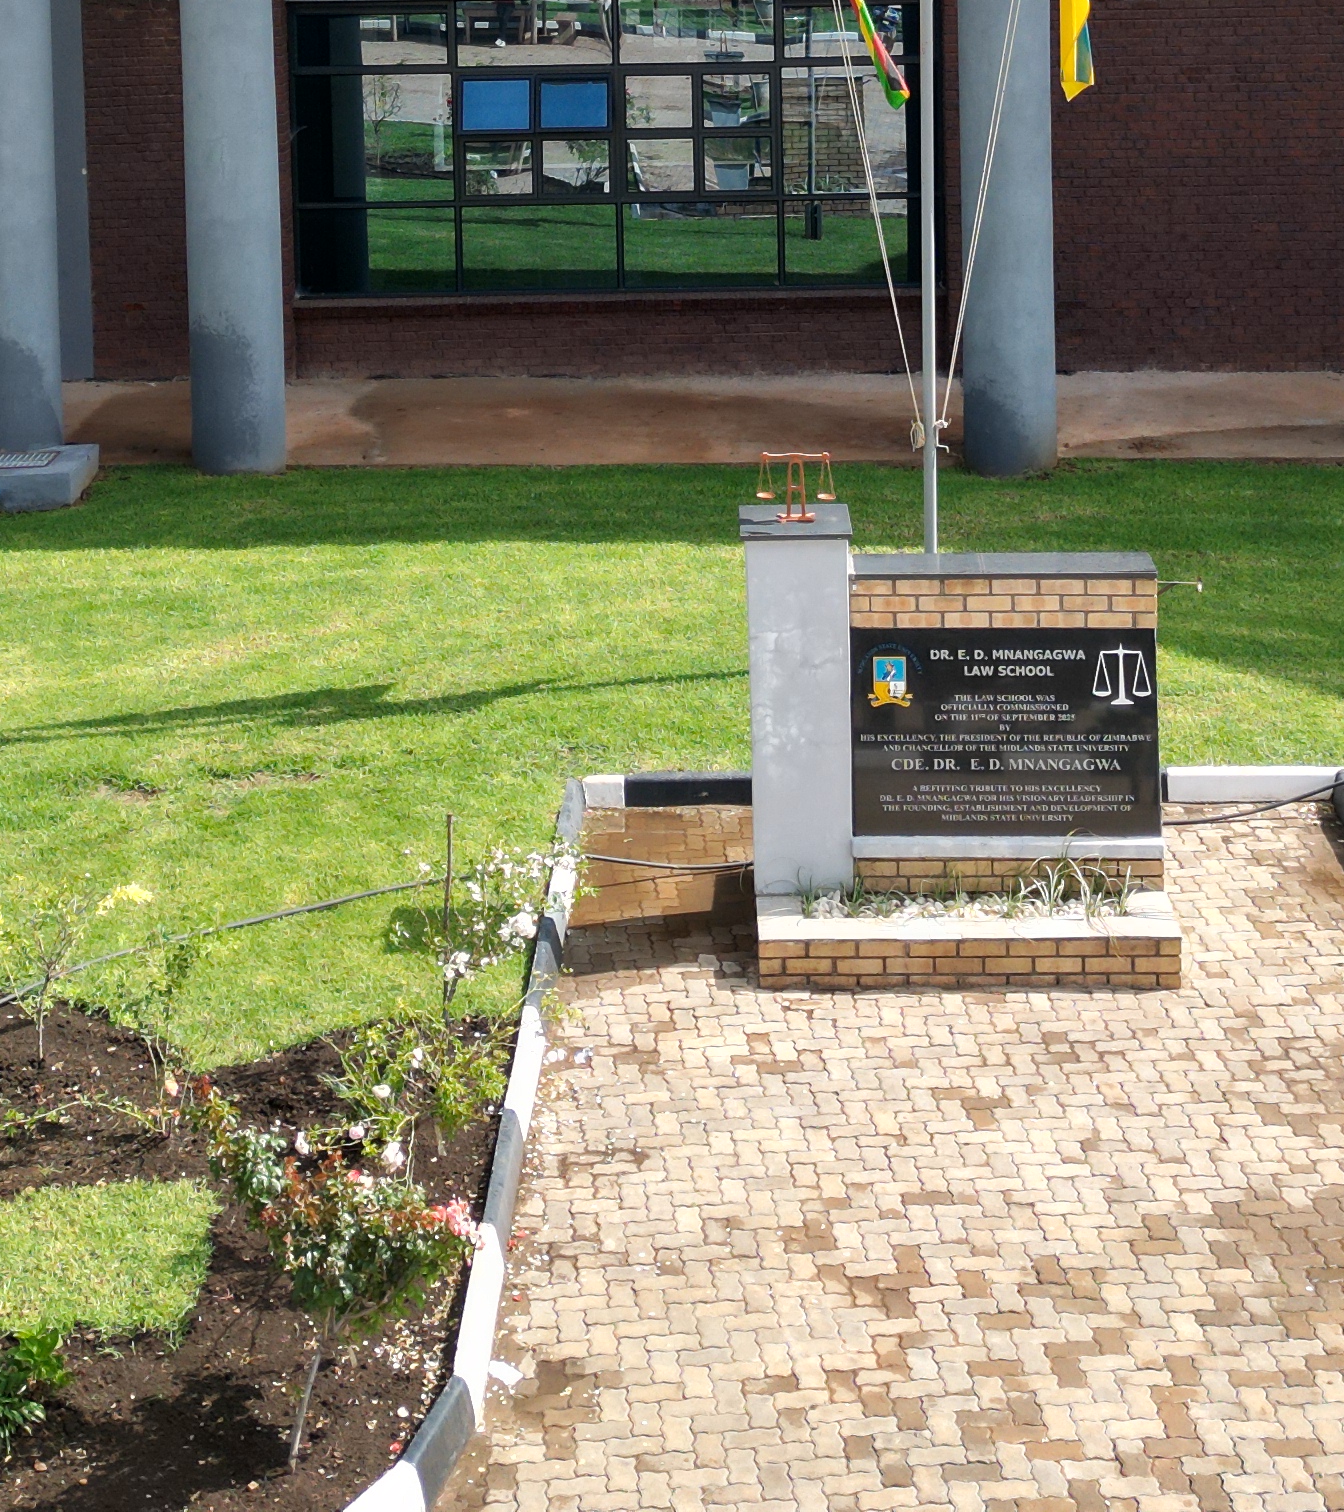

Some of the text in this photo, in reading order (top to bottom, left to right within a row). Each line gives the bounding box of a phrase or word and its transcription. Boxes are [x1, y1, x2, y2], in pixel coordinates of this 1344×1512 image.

[930, 649, 1086, 660] DR. E. D. MNANGAGWA
[964, 666, 1054, 676] LAW SCHOOL
[954, 694, 1055, 702] THE LAW SCHOOL WAS
[934, 714, 948, 722] ON
[950, 714, 968, 722] THE
[987, 714, 998, 722] OF
[1001, 714, 1055, 722] SEPTEMBER
[860, 734, 875, 742] HIS
[940, 734, 956, 742] THE
[960, 734, 1007, 742] PRESIDENT
[1010, 734, 1021, 742] OF
[1024, 734, 1042, 742] THE
[1044, 734, 1088, 742] REPUBLIC
[1089, 734, 1100, 742] OF
[1103, 734, 1152, 742] ZIMBABWE
[884, 744, 1130, 752] AND CHANCELLOR OF THE MIDLANDS STATE UNIVERSITY
[892, 758, 1122, 770] CDE. DR. E. D. MNANGAGWA
[970, 784, 1008, 792] TRIBUTE
[1010, 784, 1022, 792] TO
[1024, 784, 1040, 792] HIS
[1042, 784, 1102, 792] EXCELLENCY
[882, 804, 901, 812] THE
[954, 804, 1027, 812] ESTABLISHMENT
[1030, 804, 1048, 812] AND
[1050, 804, 1118, 812] DEVELOPMENT
[1120, 804, 1132, 812] OF
[942, 814, 1074, 822] MIDLANDS STATE UNIVERSITY
